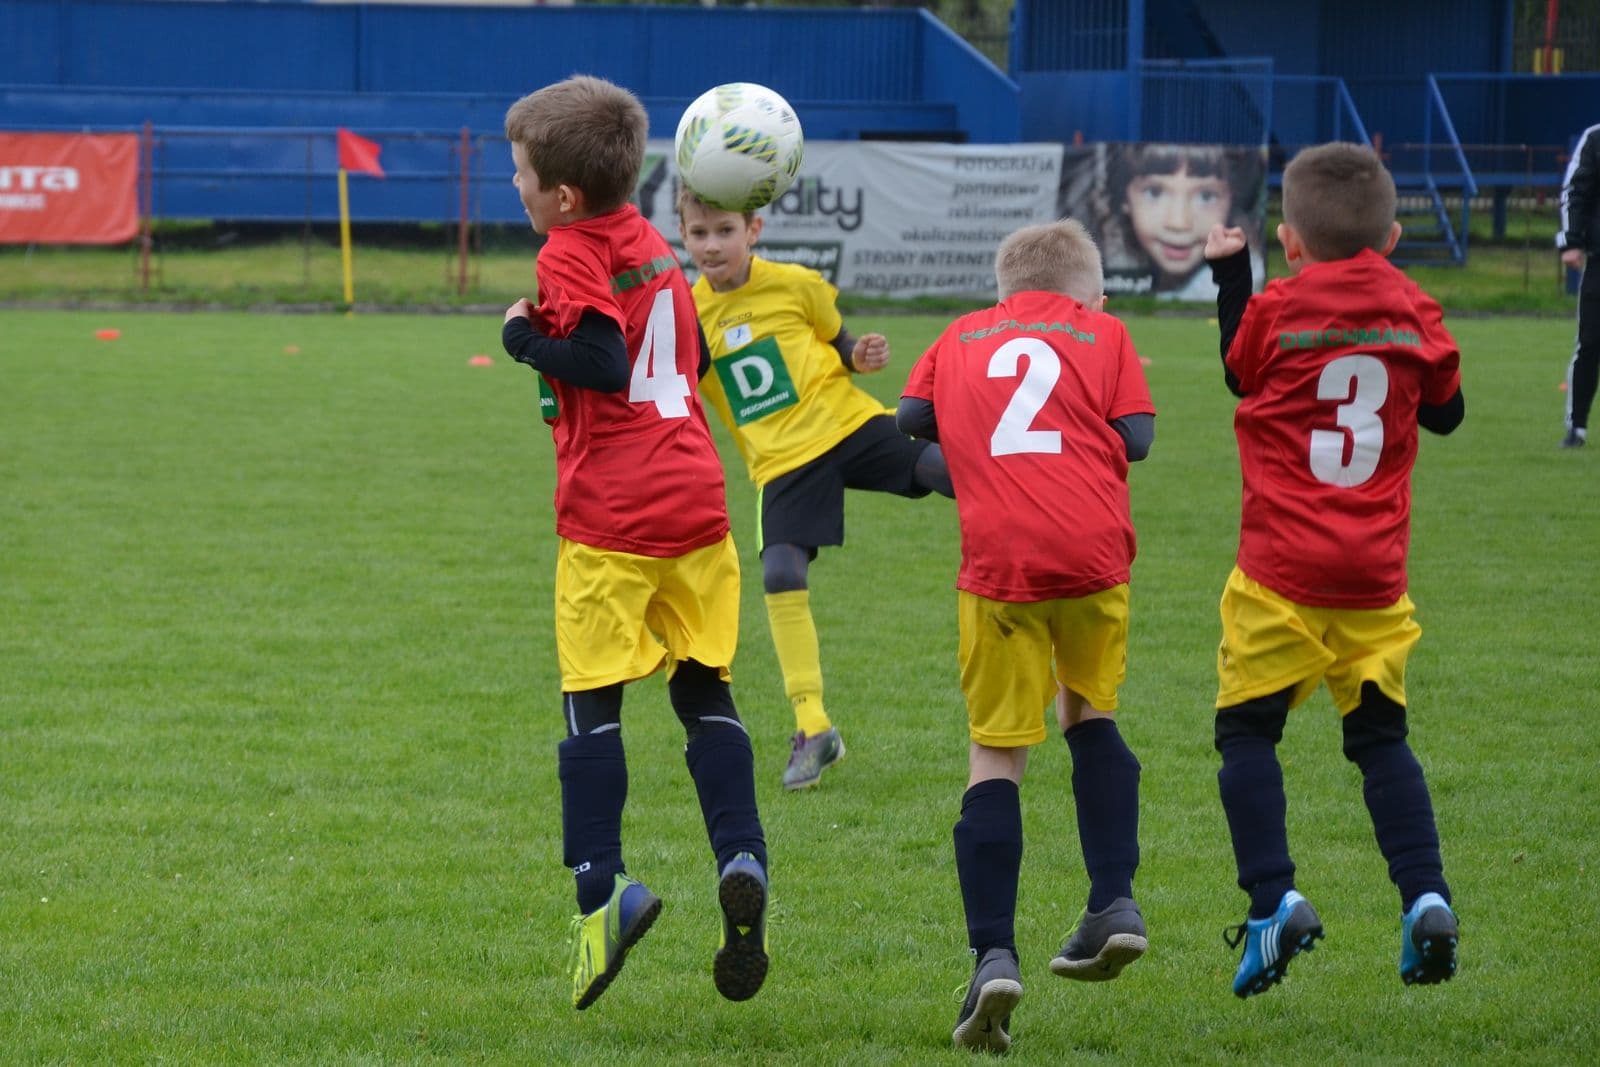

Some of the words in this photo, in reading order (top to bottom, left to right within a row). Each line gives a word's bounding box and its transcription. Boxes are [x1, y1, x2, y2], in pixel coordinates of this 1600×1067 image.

[919, 252, 997, 266] INTERNET
[628, 288, 692, 419] 4
[1279, 328, 1421, 350] DEICHMANN
[730, 355, 775, 400] D
[987, 336, 1062, 457] 2
[740, 391, 790, 418] DEICHMANN
[1309, 354, 1389, 489] 3
